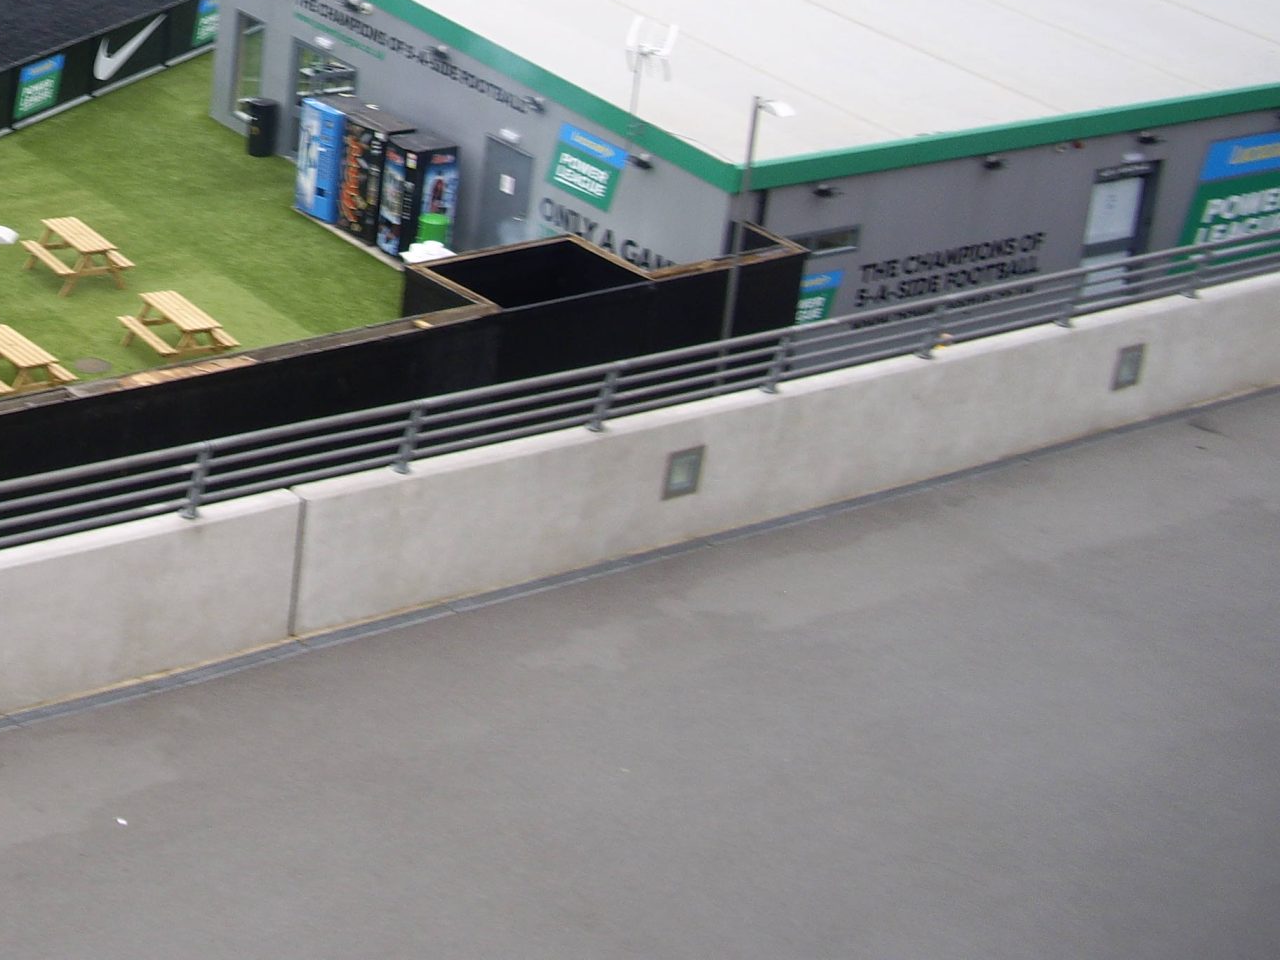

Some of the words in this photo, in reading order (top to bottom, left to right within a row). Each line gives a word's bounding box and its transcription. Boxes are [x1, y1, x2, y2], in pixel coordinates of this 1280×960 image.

[859, 259, 899, 283] THE
[901, 237, 1015, 275] CHAMPIONS
[1020, 231, 1046, 253] OF
[945, 255, 1041, 289] FOOTBALL
